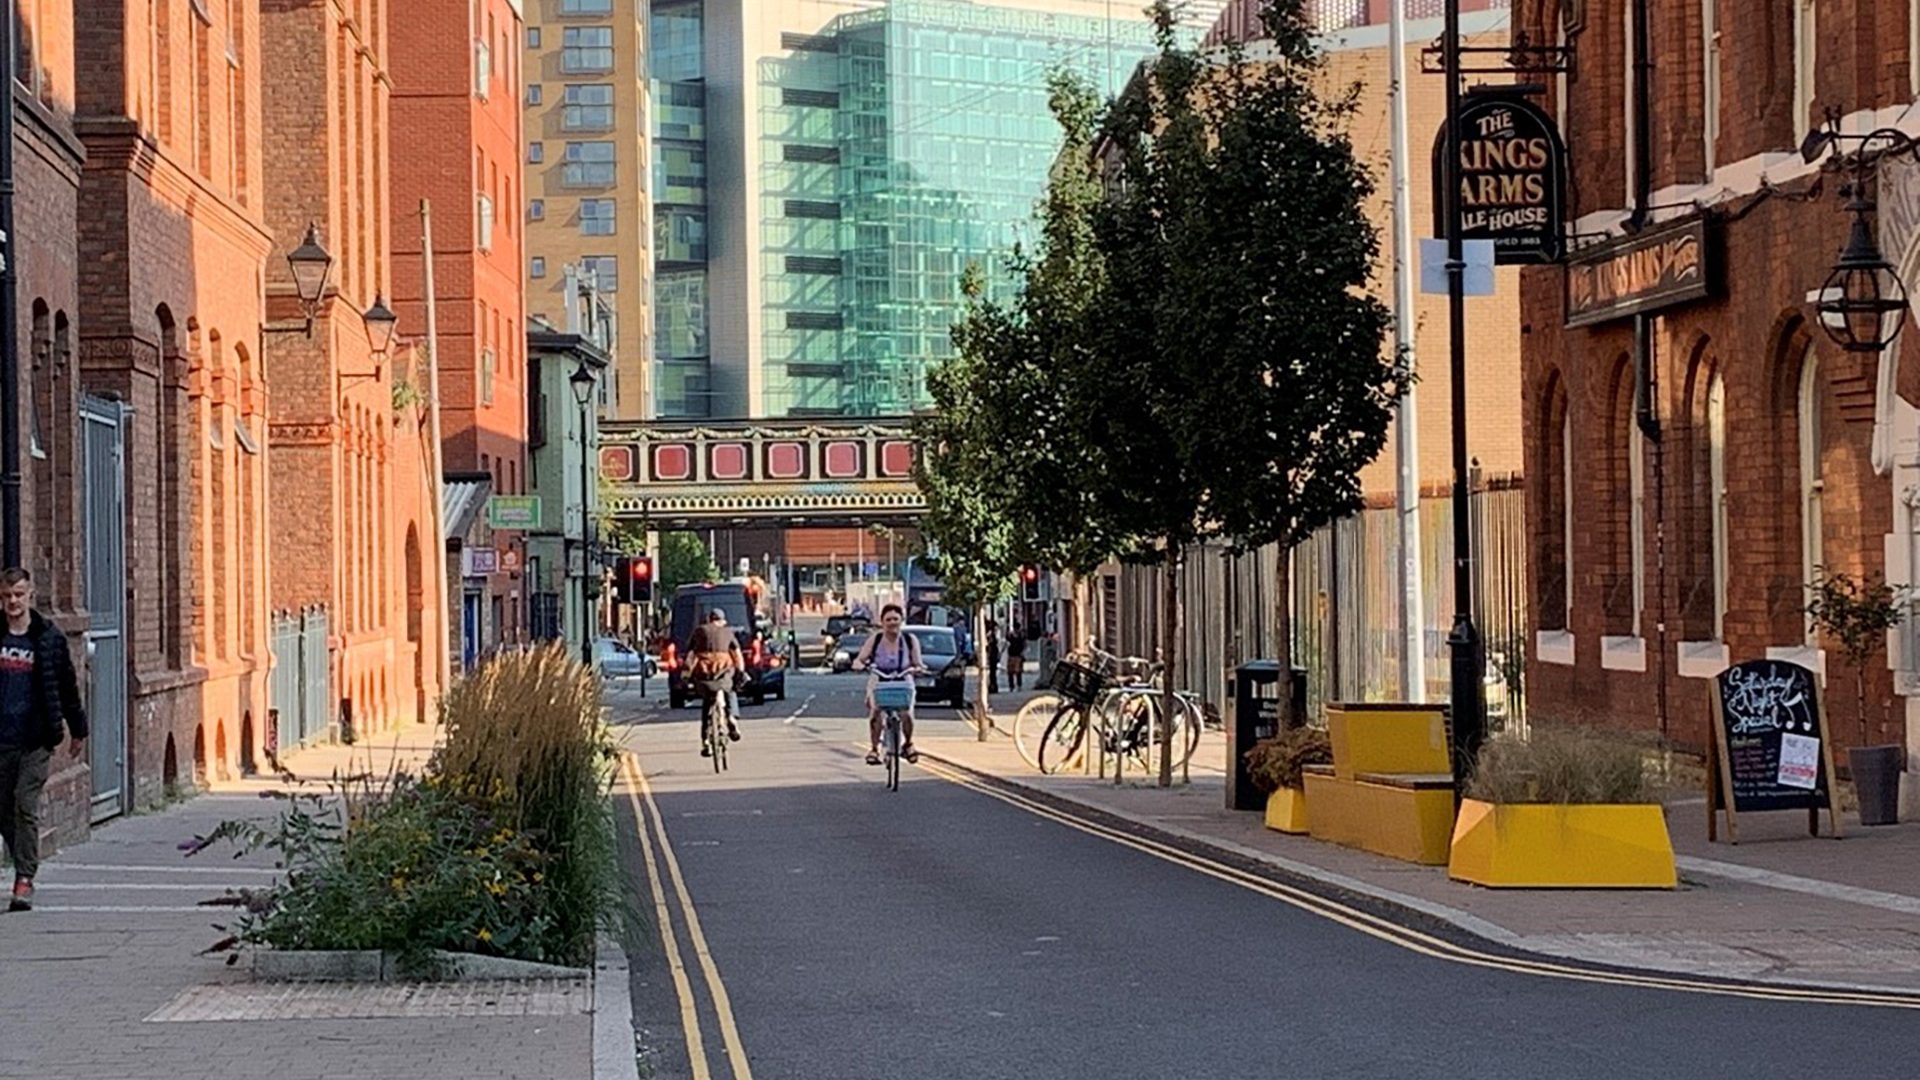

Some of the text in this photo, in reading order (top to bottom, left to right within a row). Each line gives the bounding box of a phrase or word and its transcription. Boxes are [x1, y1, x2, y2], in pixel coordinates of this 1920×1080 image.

[1476, 111, 1514, 136] THE
[1461, 174, 1545, 205] ARMS
[1489, 207, 1548, 231] HOUSE
[1597, 254, 1629, 300] KINGS
[1628, 244, 1660, 294] ARMS
[1729, 664, 1796, 700] Saturday
[1727, 699, 1782, 733] Special
[1736, 689, 1780, 717] Night
